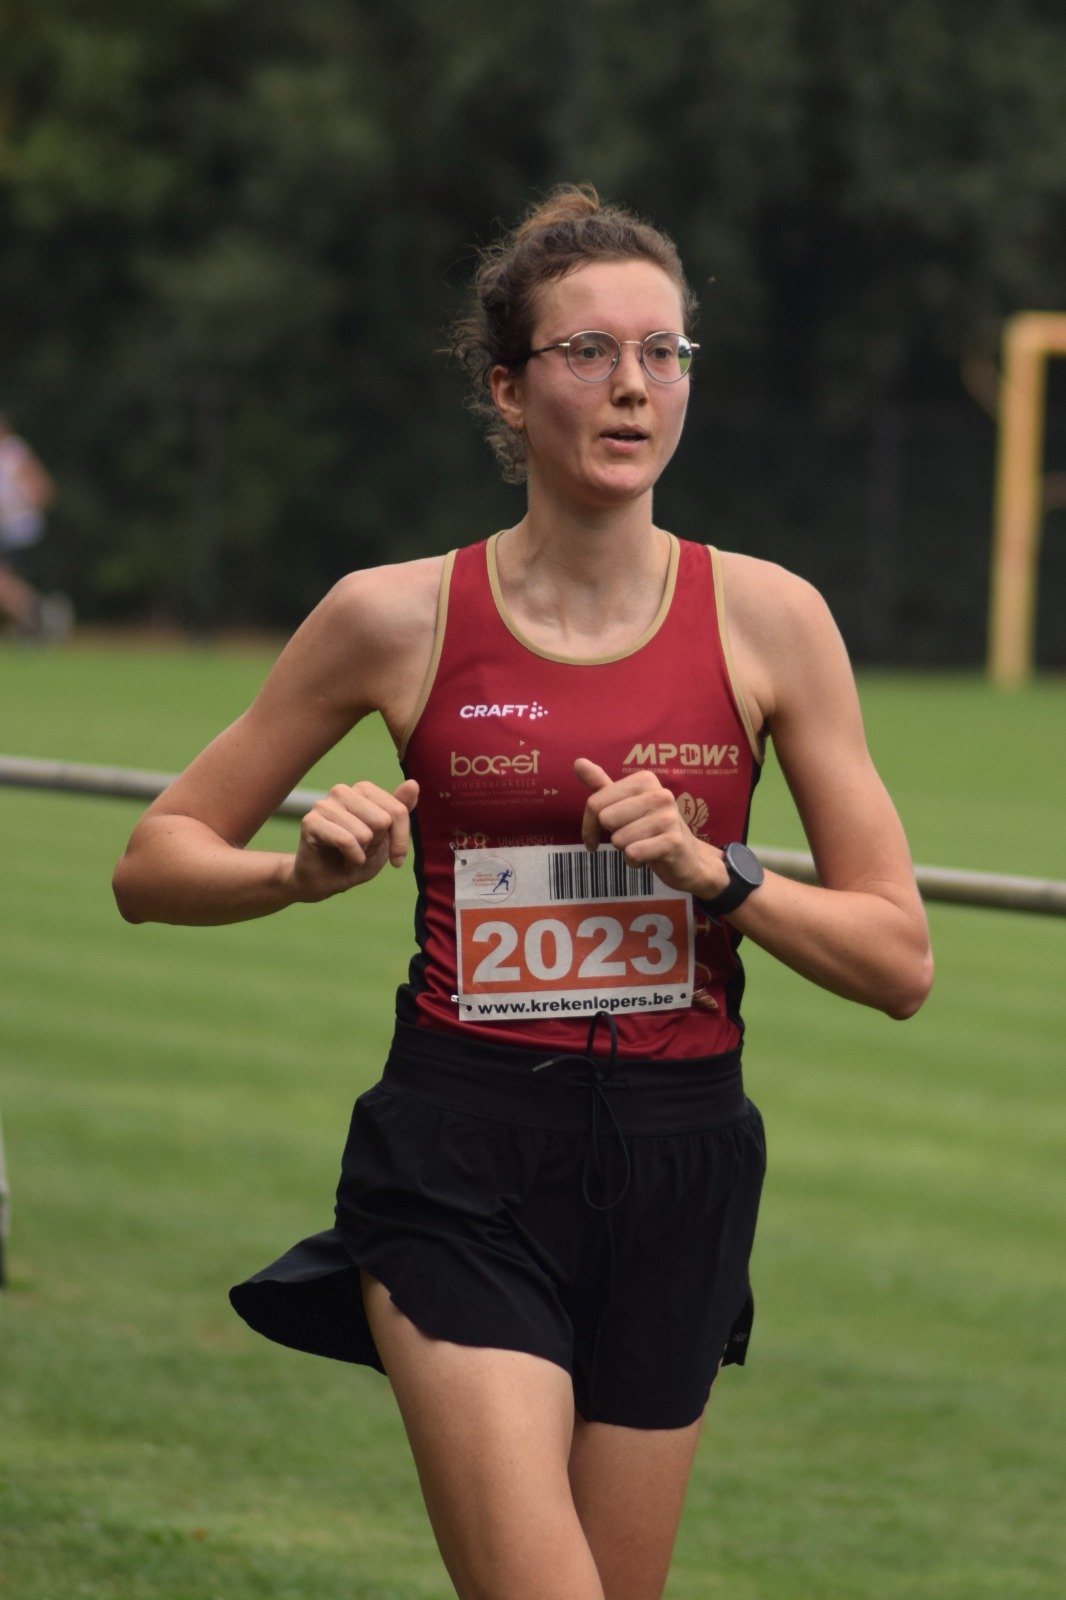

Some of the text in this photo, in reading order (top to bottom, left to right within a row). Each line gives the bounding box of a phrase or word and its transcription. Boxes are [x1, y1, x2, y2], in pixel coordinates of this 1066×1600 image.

[460, 704, 529, 718] CRAFT
[450, 749, 540, 776] boest
[622, 743, 739, 766] MPOWR
[472, 913, 678, 983] 2023
[478, 992, 674, 1015] www.krekenlopers.be
